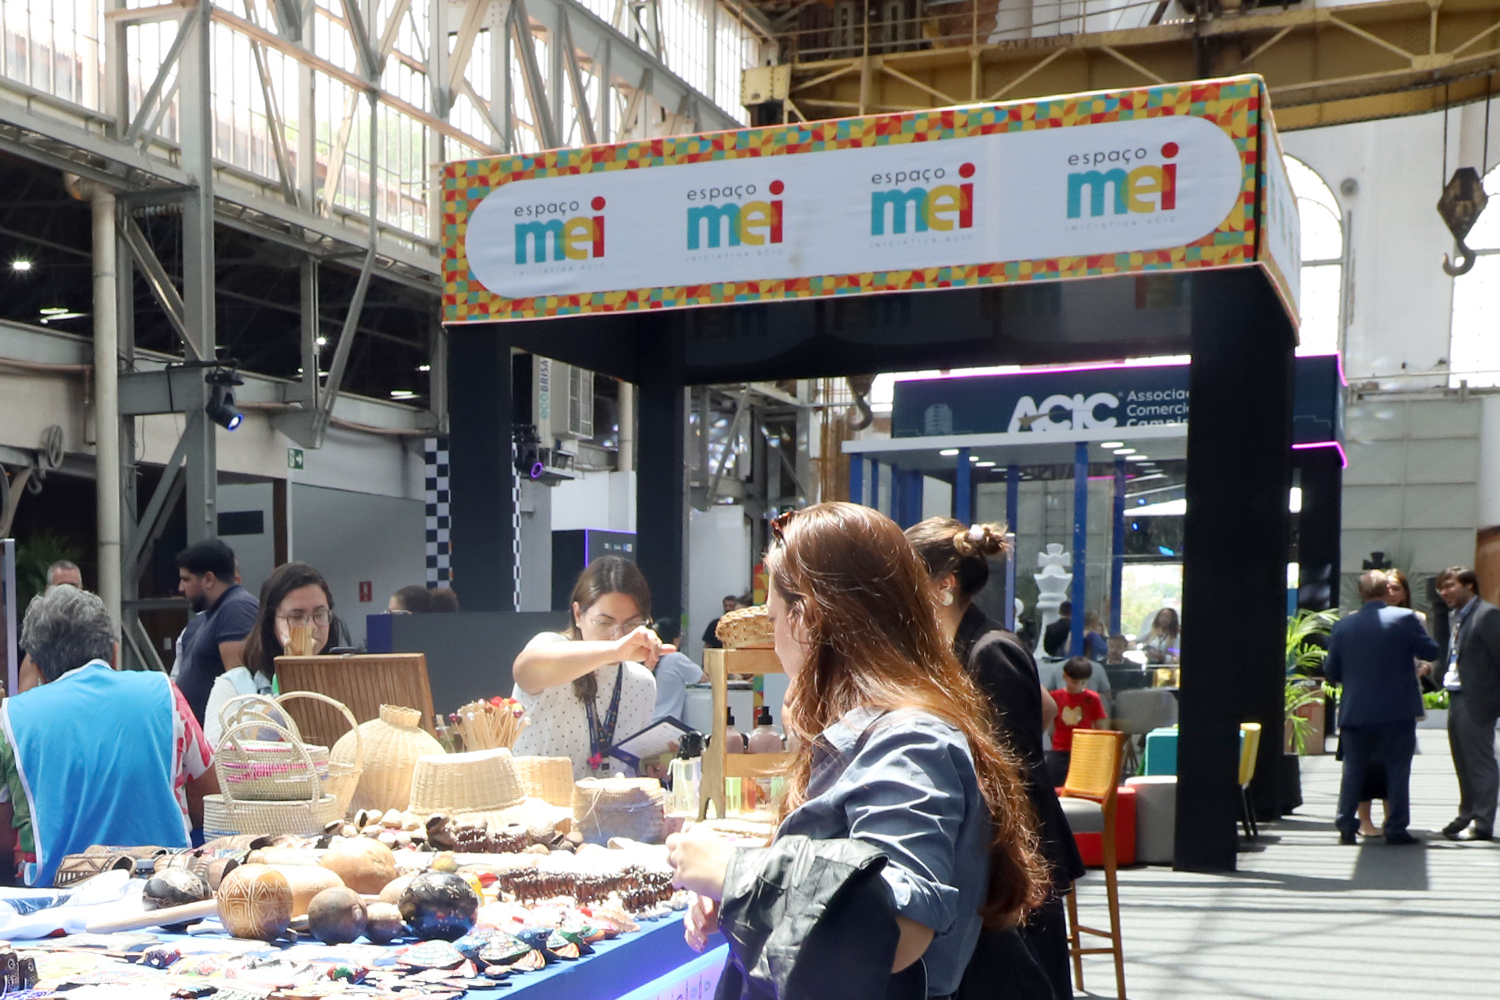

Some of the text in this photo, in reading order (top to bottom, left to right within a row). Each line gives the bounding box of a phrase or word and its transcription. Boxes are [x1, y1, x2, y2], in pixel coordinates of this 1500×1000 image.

[1067, 147, 1147, 166] espaço
[871, 168, 946, 186] espaço
[1066, 142, 1179, 219] mei
[687, 184, 757, 202] espaço
[871, 162, 976, 236] mei
[514, 201, 580, 218] espaço
[687, 179, 785, 250] mei
[515, 196, 606, 264] mei
[1007, 392, 1120, 432] ACIC
[1127, 402, 1189, 417] Comerci
